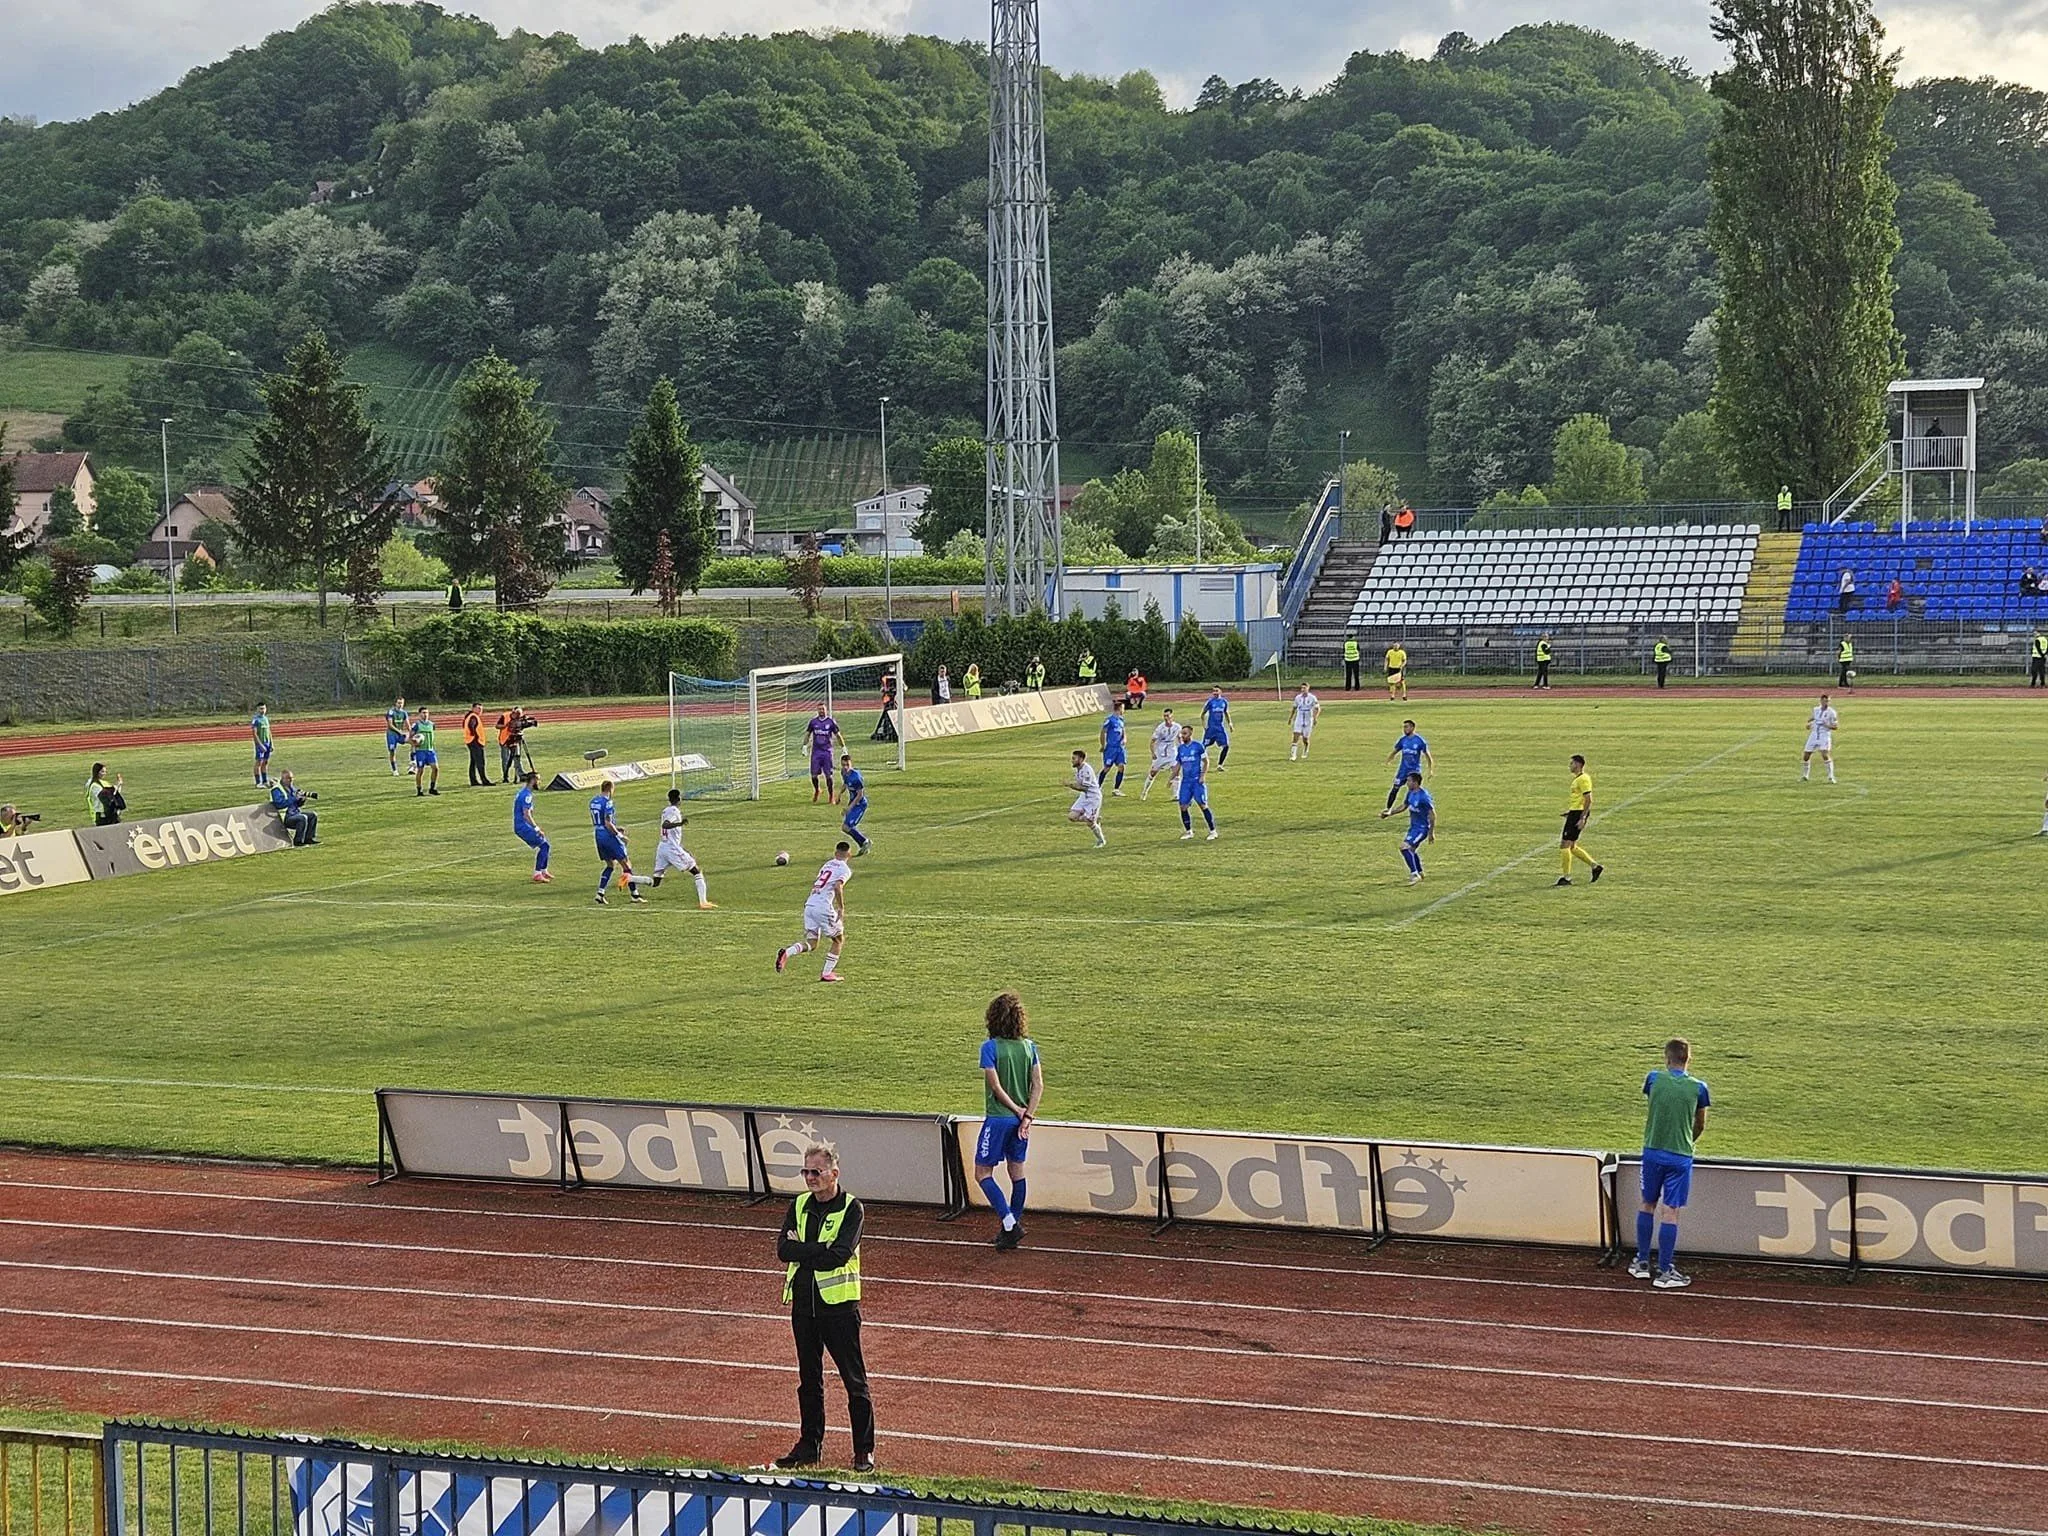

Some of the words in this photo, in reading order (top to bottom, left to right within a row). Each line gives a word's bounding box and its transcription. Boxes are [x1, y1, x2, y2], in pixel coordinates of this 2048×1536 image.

[989, 699, 1036, 726] efbet
[1061, 687, 1105, 716] efbet
[912, 709, 965, 738] efbet
[132, 814, 256, 869] efbet
